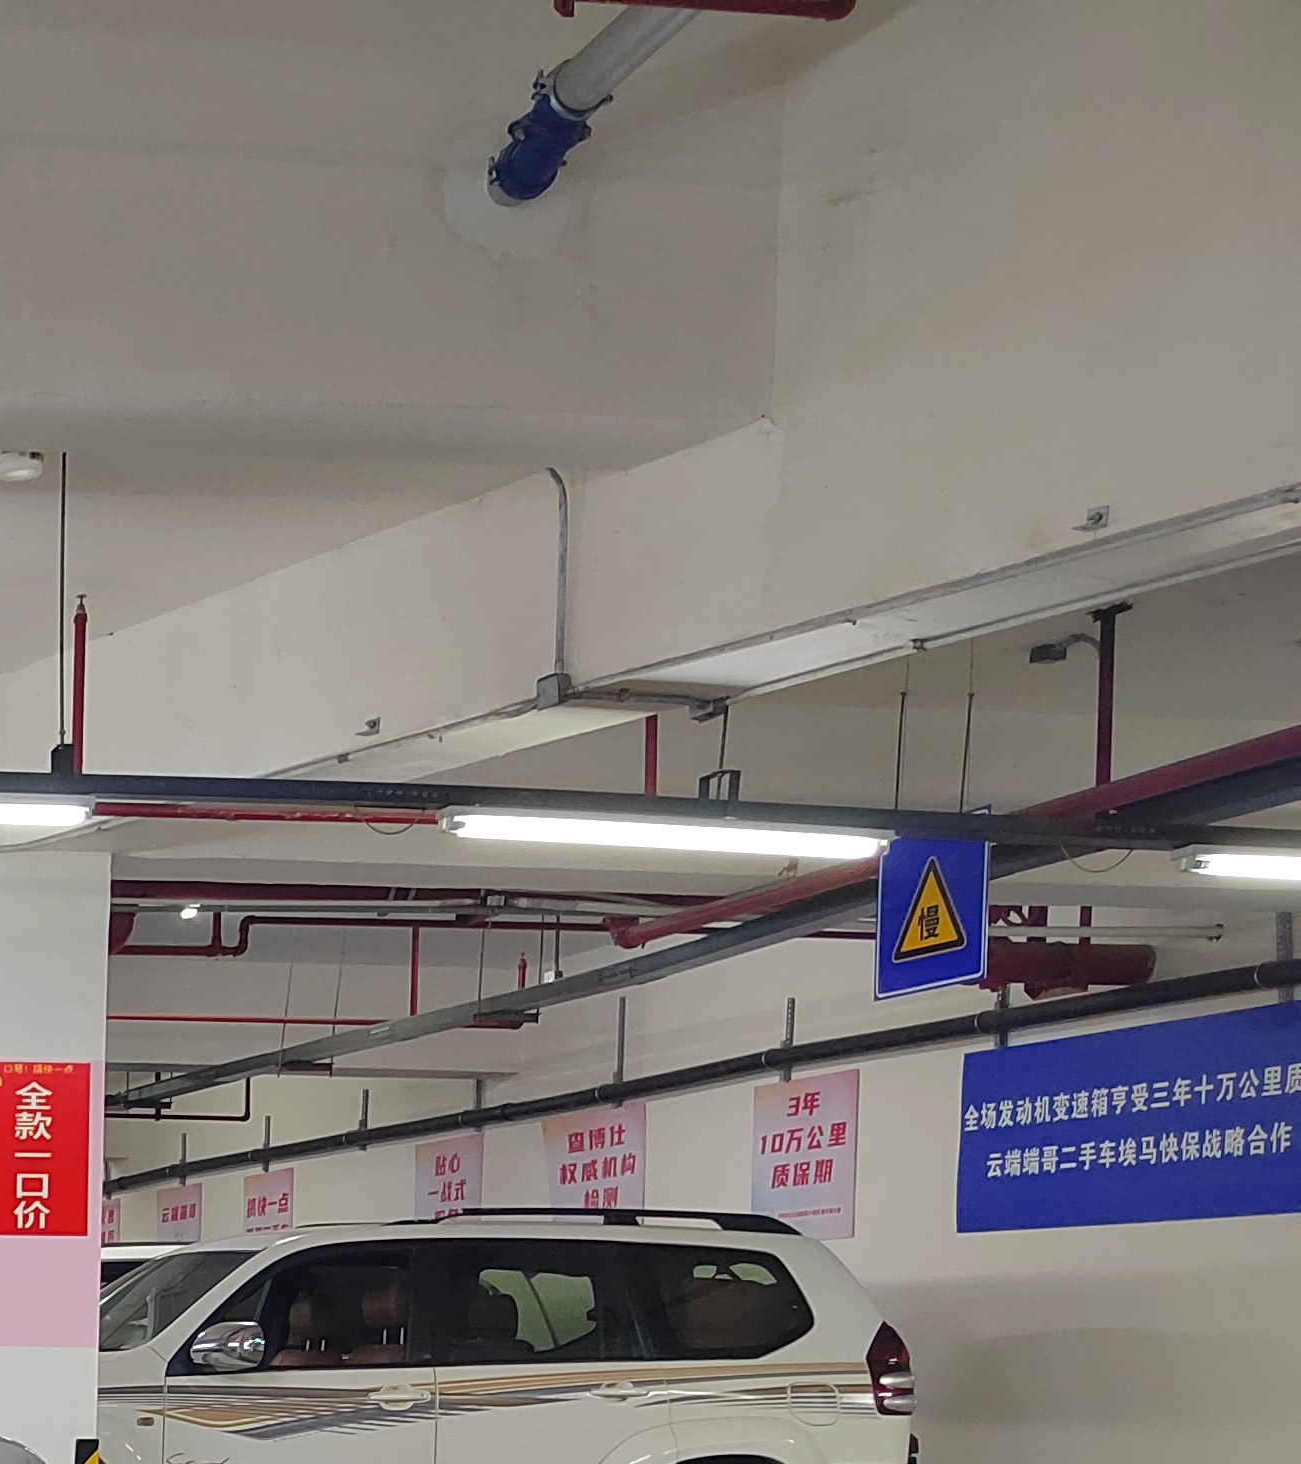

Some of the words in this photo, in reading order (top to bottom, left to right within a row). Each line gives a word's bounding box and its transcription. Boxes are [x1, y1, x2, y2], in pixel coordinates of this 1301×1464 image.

[917, 904, 940, 941] 慢
[787, 1091, 821, 1117] 3年
[760, 1122, 847, 1154] 10万公里
[13, 1081, 53, 1229] 全款一口价
[434, 1152, 461, 1177] 贴心
[559, 1152, 636, 1186] 权威机构
[771, 1159, 834, 1189] 质保期
